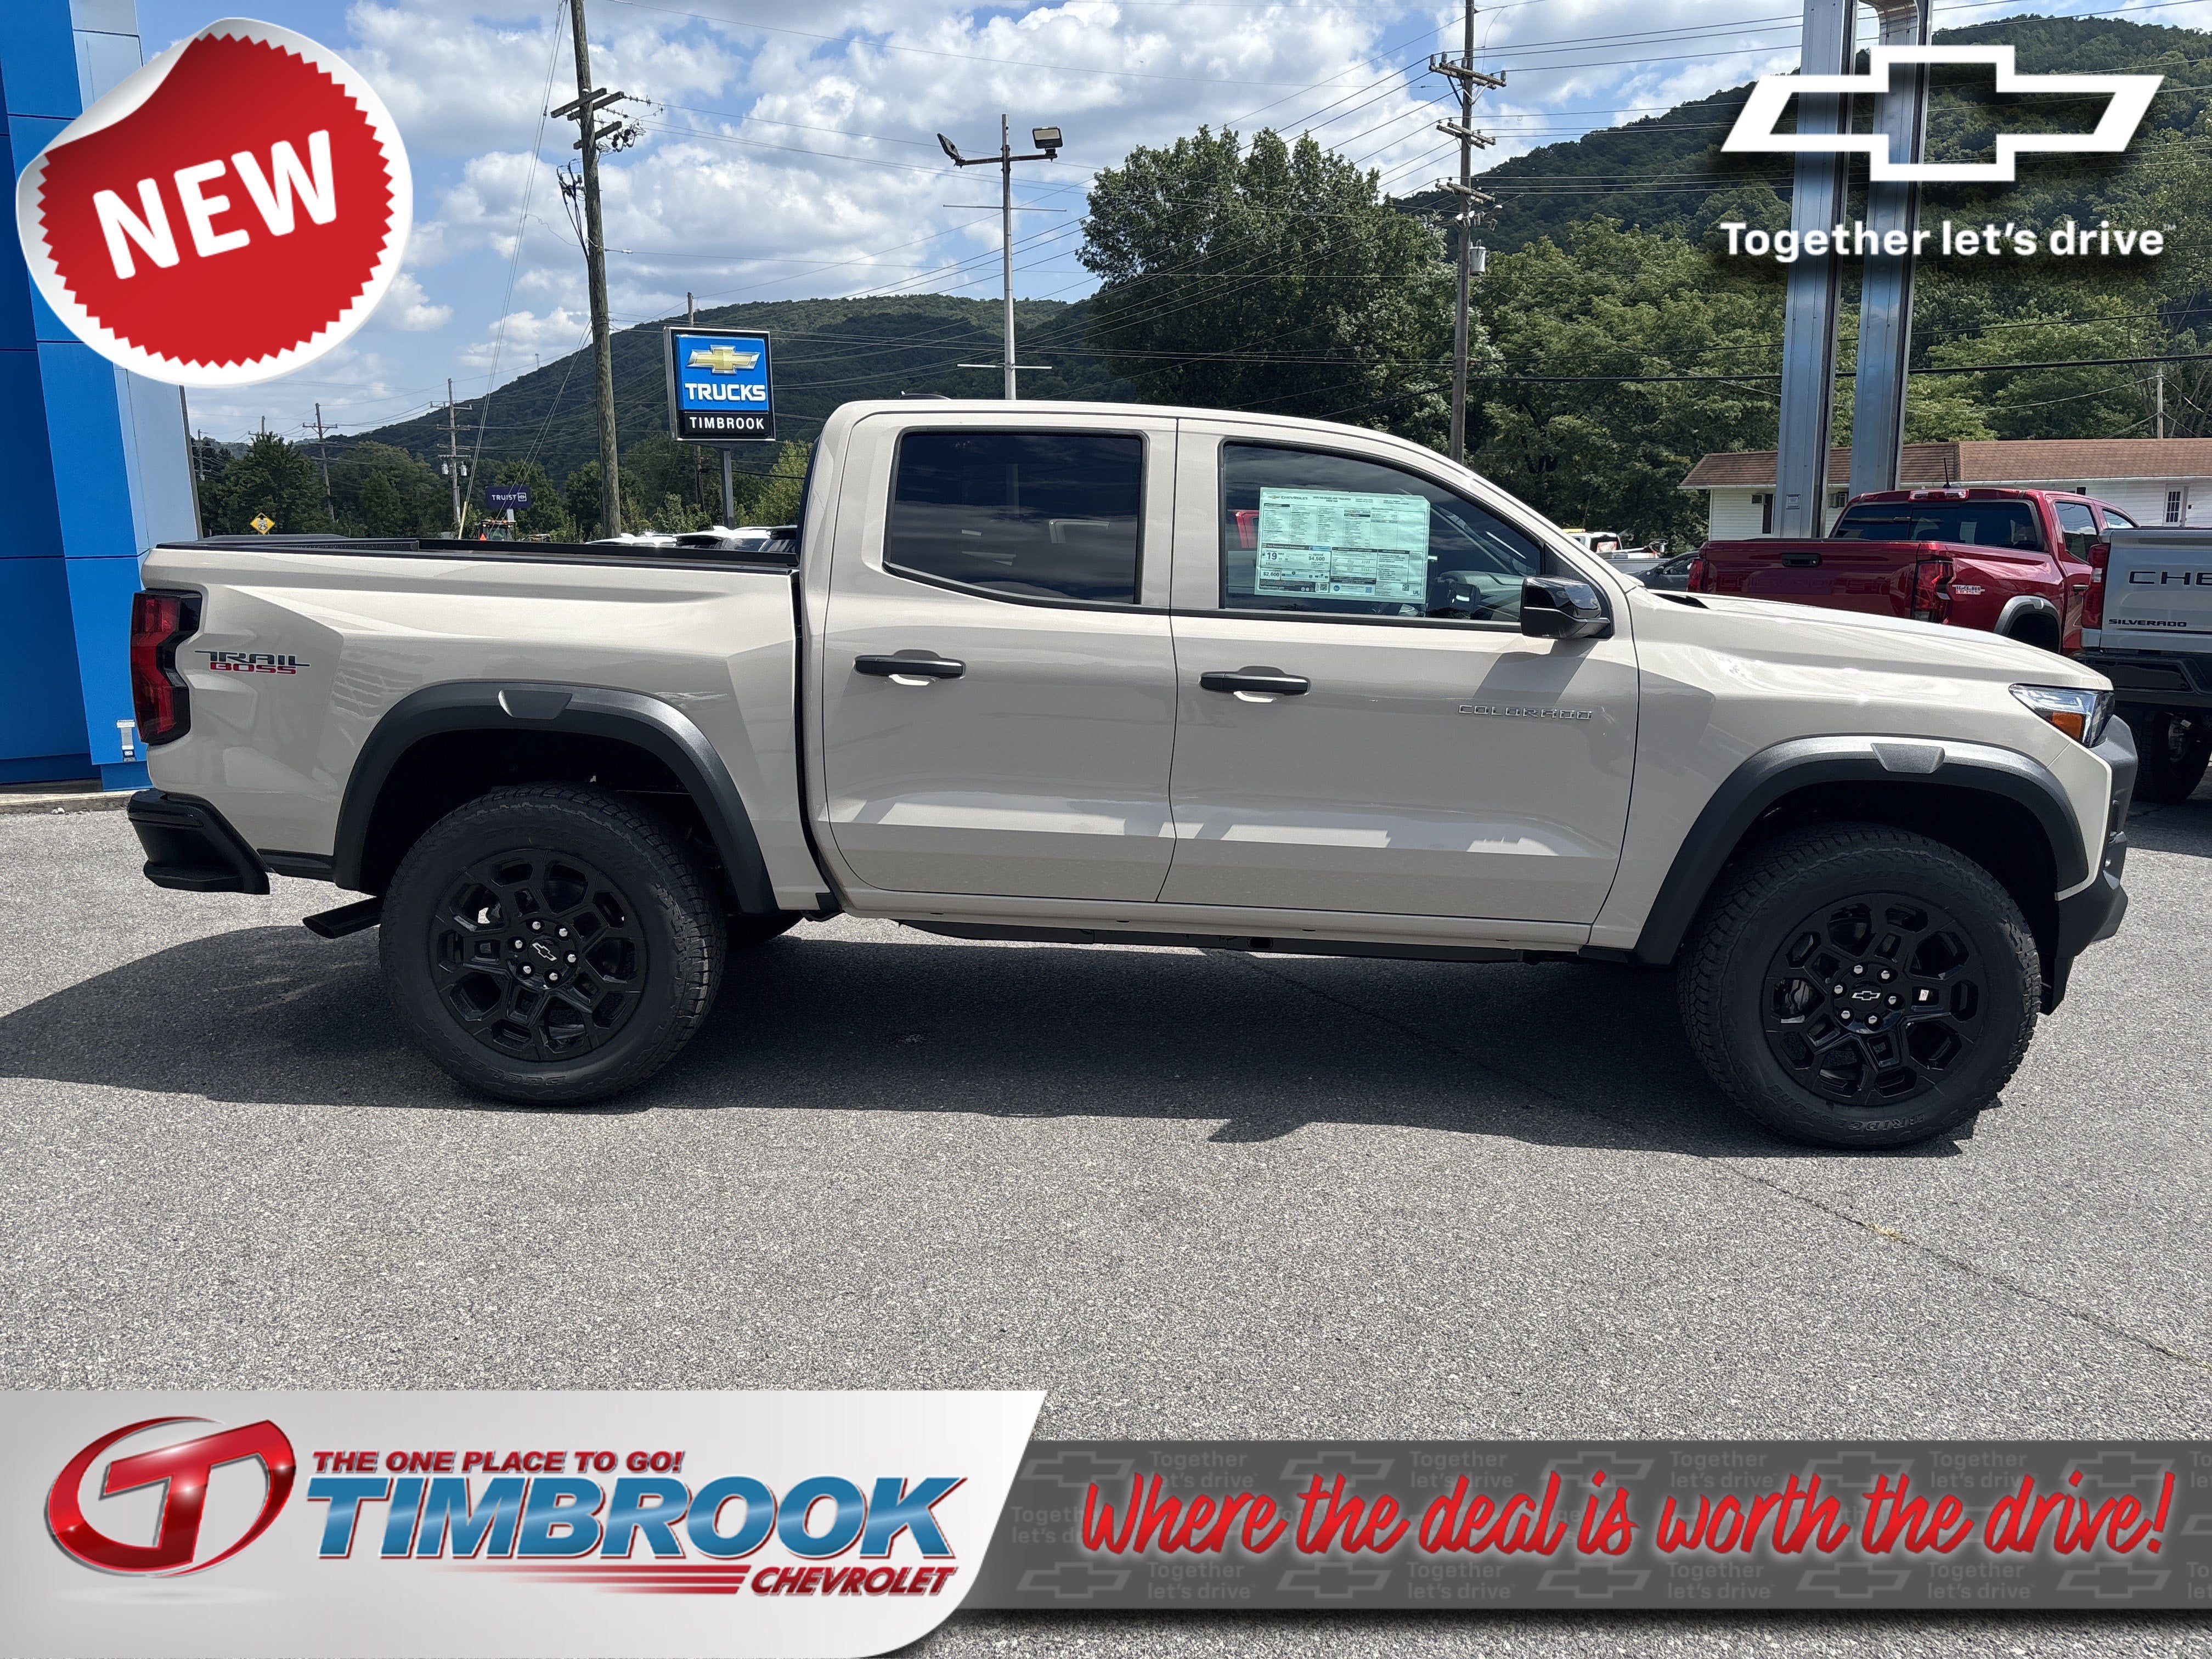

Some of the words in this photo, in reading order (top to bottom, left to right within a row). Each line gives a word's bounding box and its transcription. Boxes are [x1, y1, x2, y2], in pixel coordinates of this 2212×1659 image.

[684, 383, 766, 401] TRUCKS
[689, 416, 765, 430] TIMBROOK
[1267, 552, 1277, 560] 19
[2108, 618, 2187, 627] SILVERADO
[194, 650, 310, 667] TRAIL
[210, 662, 297, 675] BOSS
[1458, 704, 1592, 720] COLORADO
[1766, 1081, 1926, 1131] BRIDGESTONE
